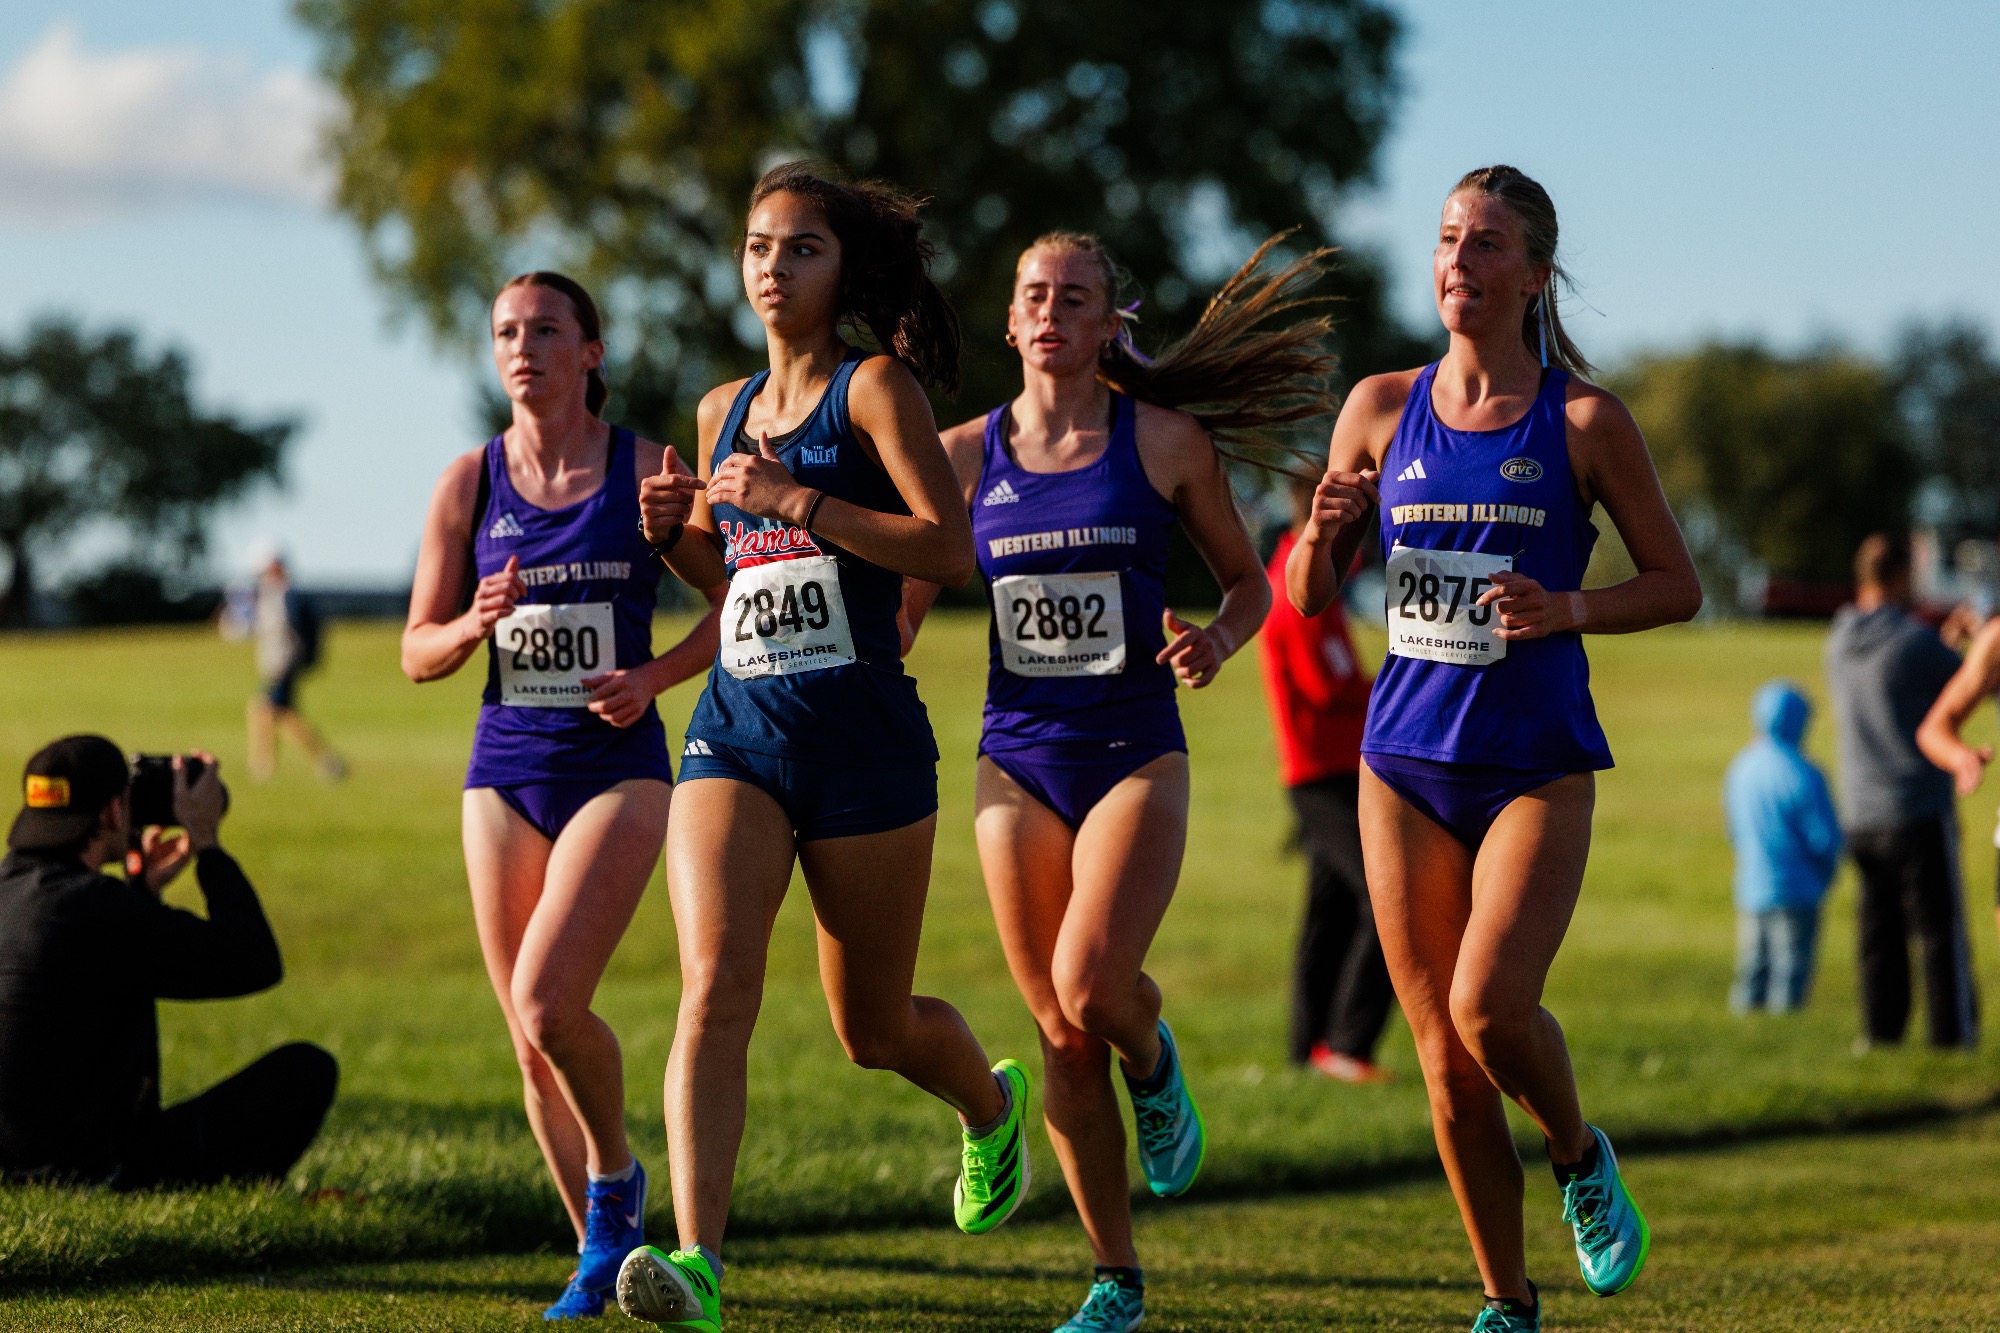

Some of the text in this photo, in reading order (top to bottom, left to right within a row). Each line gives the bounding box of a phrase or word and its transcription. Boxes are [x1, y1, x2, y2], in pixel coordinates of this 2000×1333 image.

[801, 444, 838, 465] VALLEY
[983, 494, 1020, 507] adidas
[1391, 503, 1547, 528] WESTERN ILLINOIS
[489, 528, 525, 539] adidas
[988, 526, 1137, 559] WESTERN ILLINOIS
[518, 562, 632, 586] STERN ILLINOIS
[1398, 571, 1493, 627] 2875
[733, 580, 830, 643] 2849
[1012, 593, 1109, 641] 2882
[510, 626, 600, 673] 2880
[1400, 634, 1491, 652] LAKESHORE
[737, 643, 838, 668] LAKESHORE
[1018, 651, 1111, 665] LAKESHORE
[749, 664, 785, 675] ATETC
[513, 684, 592, 695] LAKESHOR
